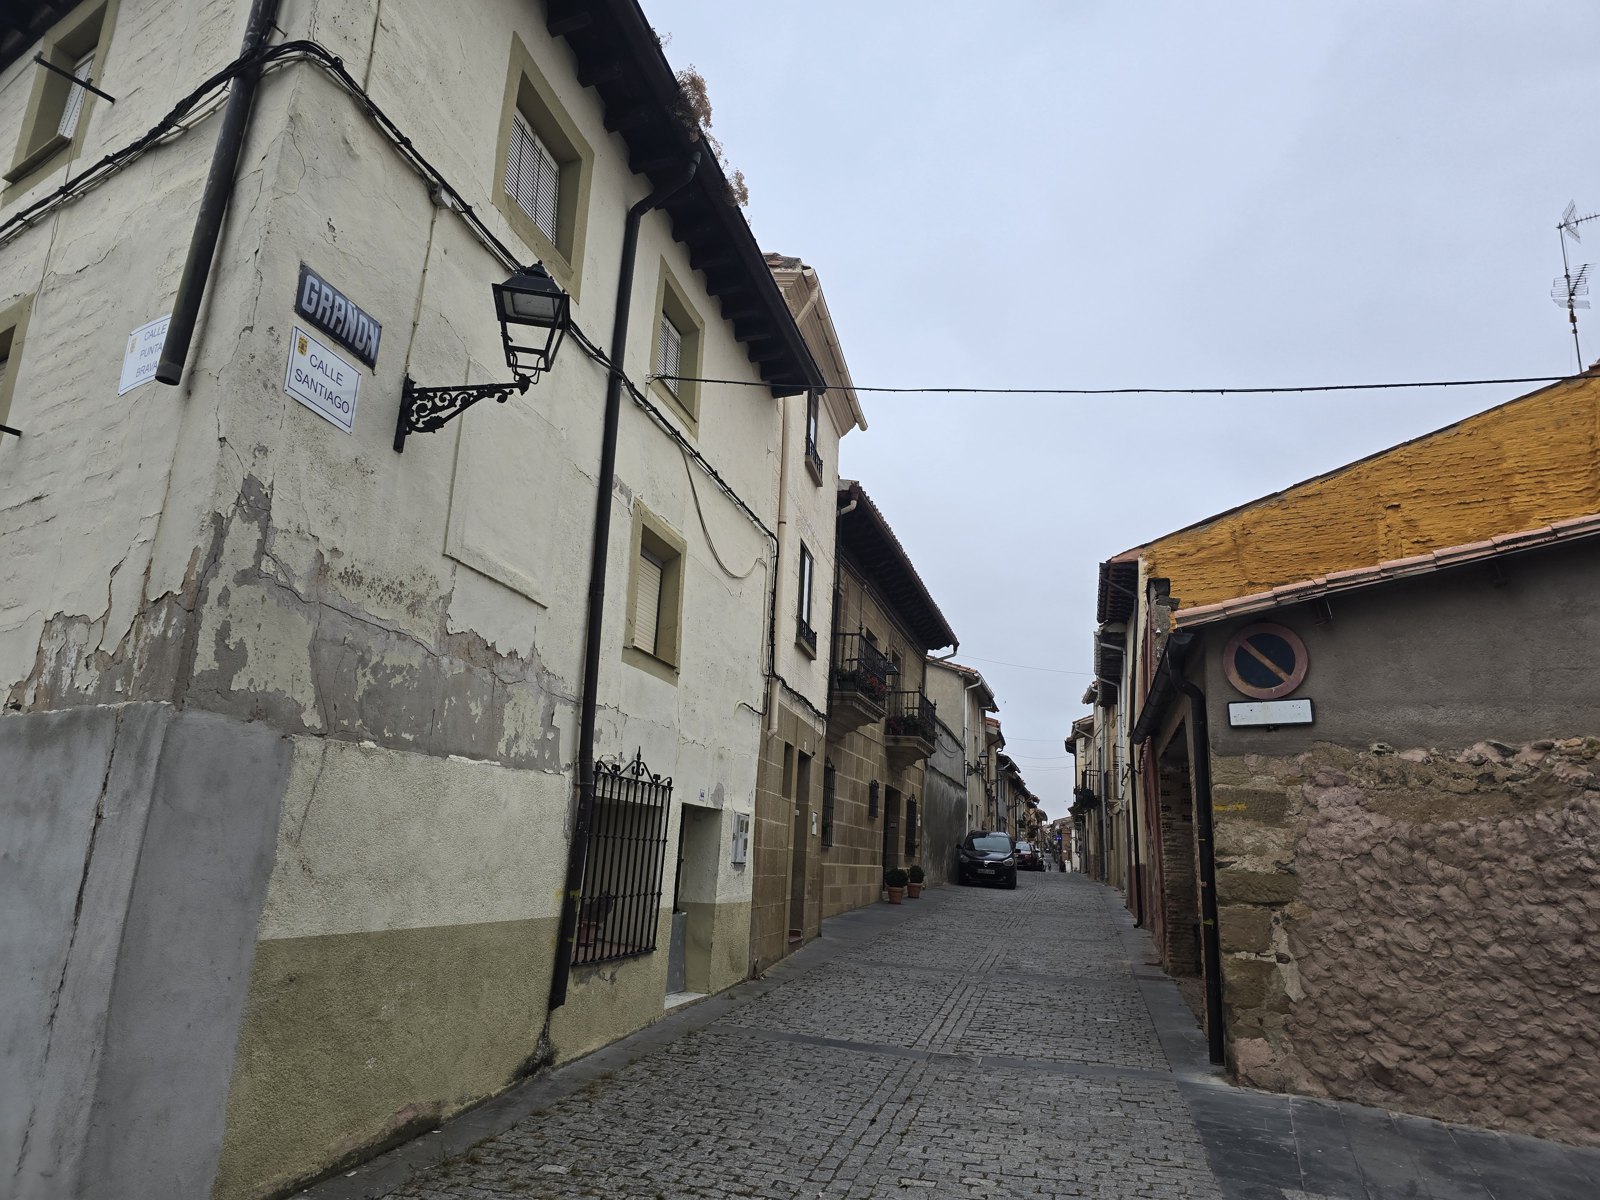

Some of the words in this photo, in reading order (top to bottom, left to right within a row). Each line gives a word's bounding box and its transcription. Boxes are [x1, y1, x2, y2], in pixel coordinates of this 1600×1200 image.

[144, 323, 168, 341] CALLE
[140, 342, 163, 357] PUNTA
[136, 361, 158, 378] BRAVA
[309, 354, 344, 387] CALLE
[294, 368, 350, 414] SANTIAGO
